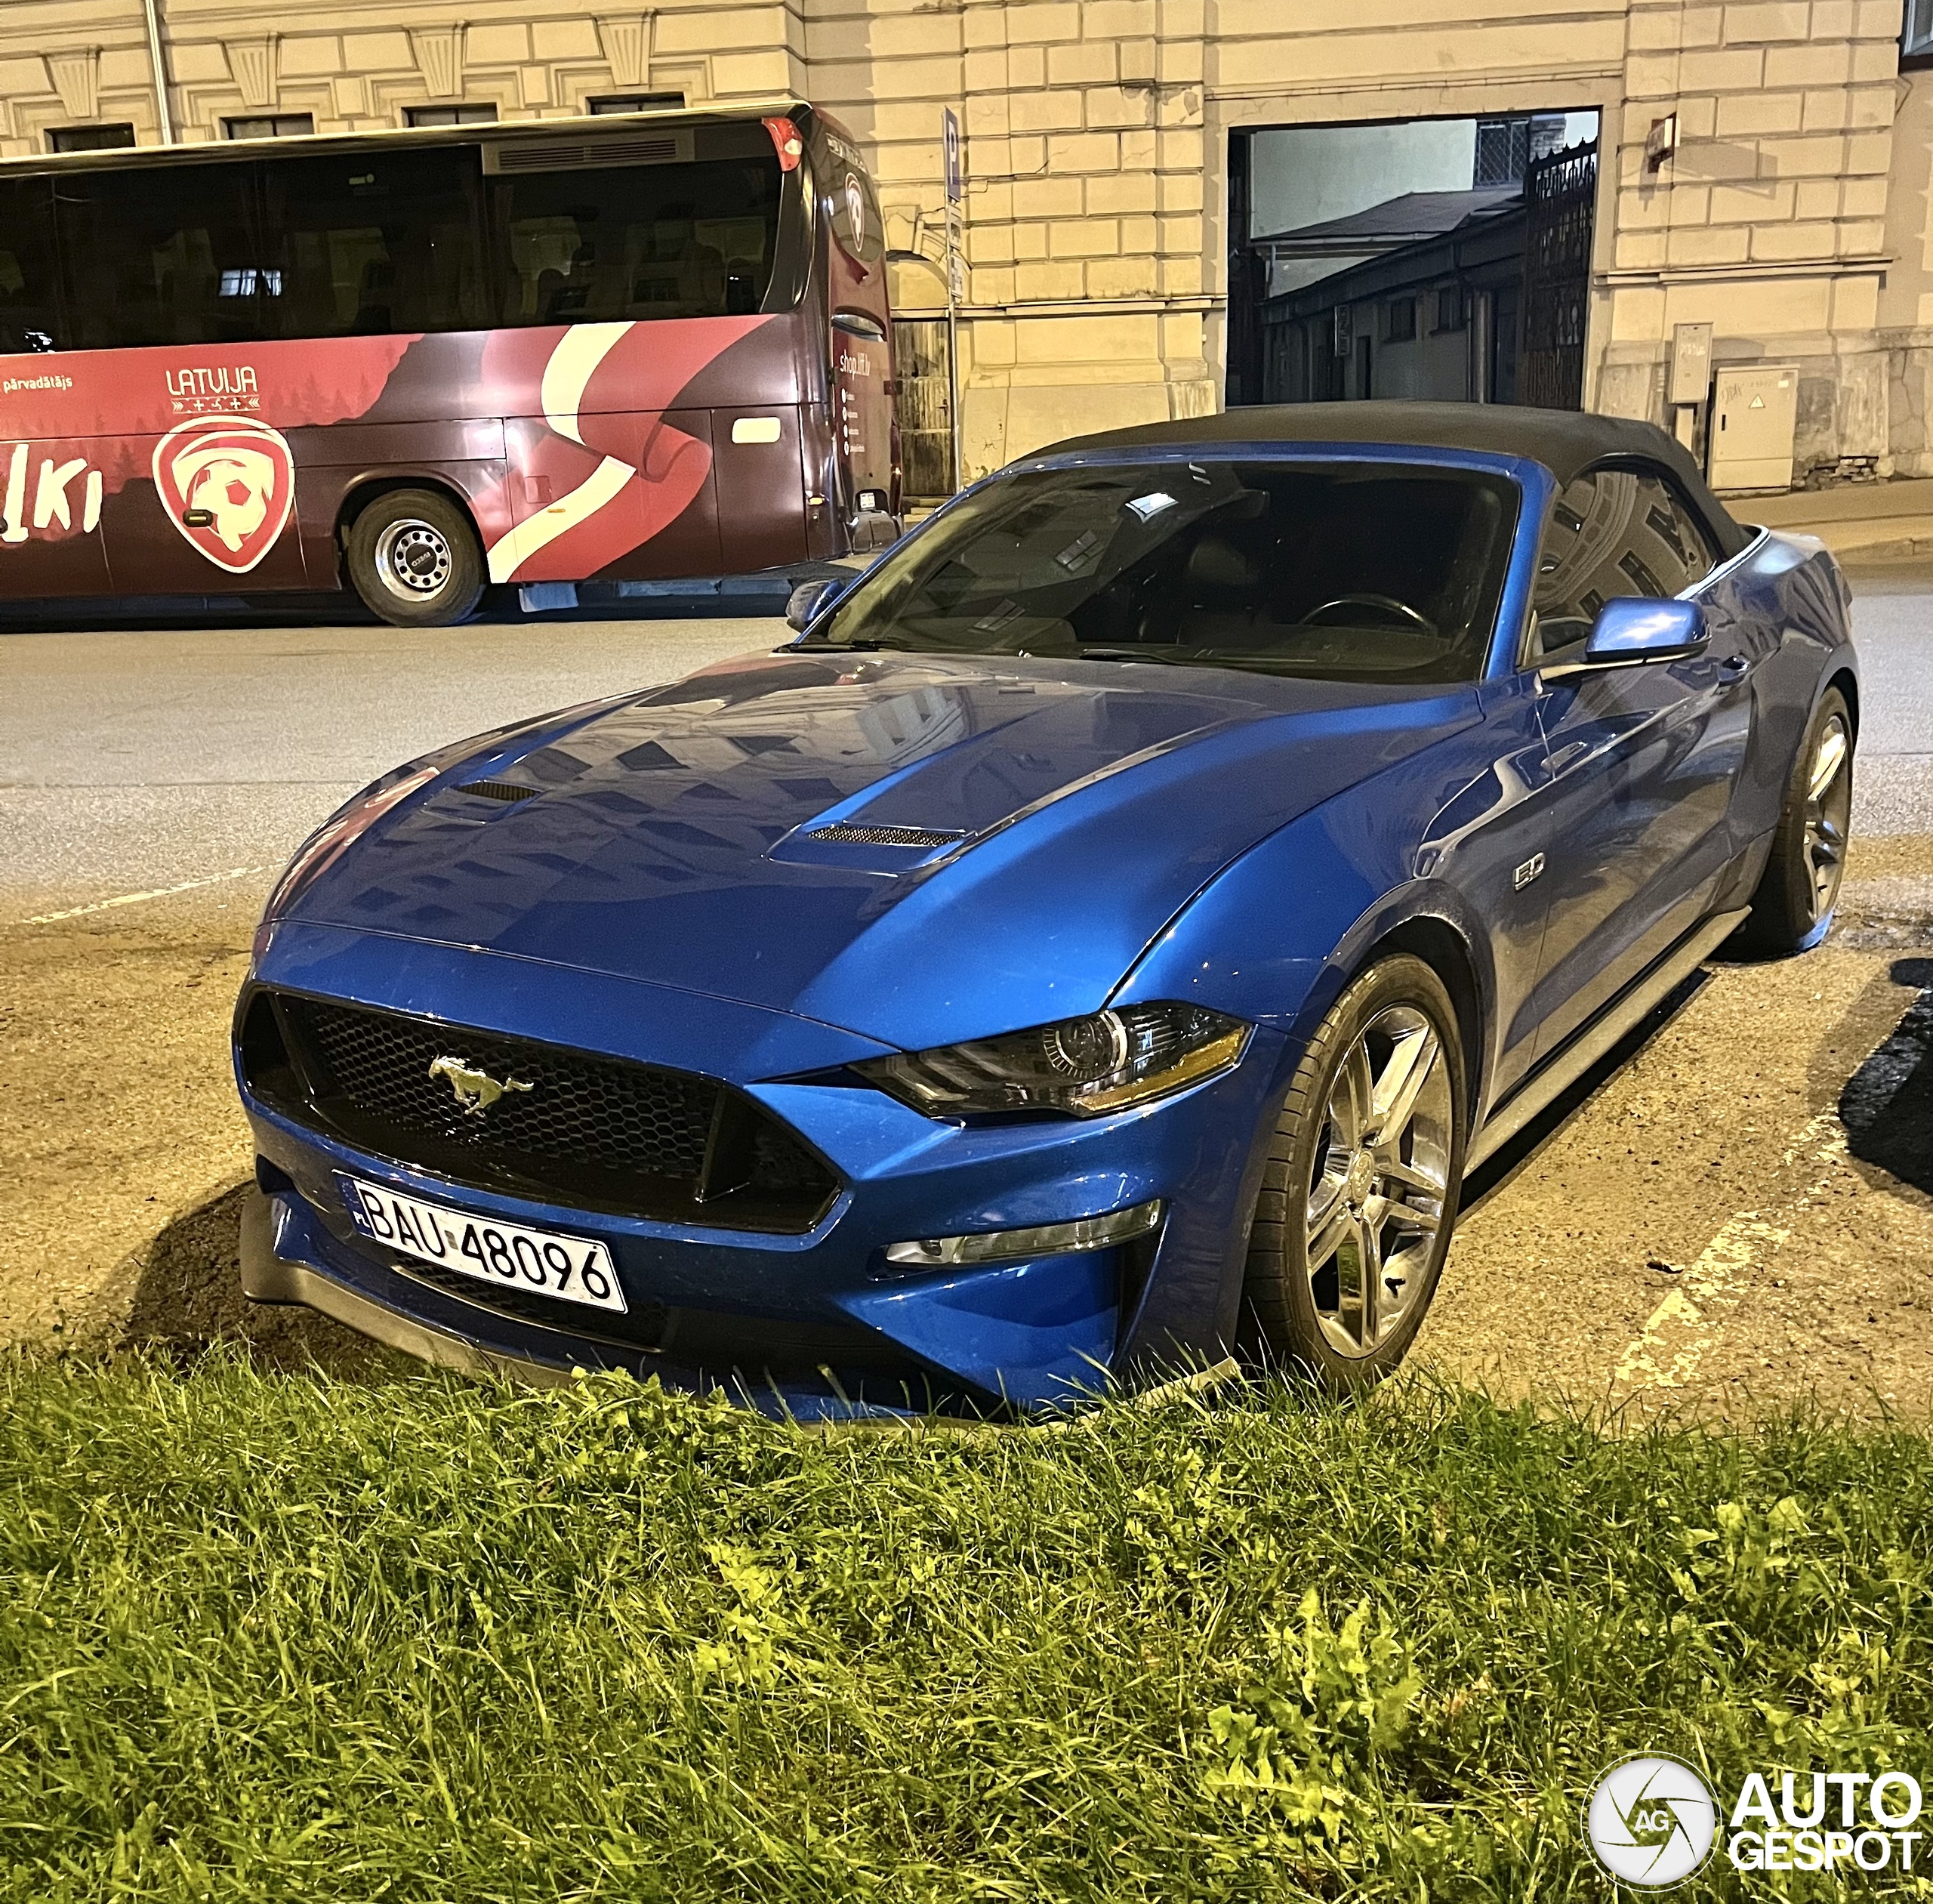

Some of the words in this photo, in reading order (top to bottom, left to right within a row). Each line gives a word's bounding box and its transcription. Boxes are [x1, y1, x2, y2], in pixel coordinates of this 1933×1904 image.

[948, 121, 957, 185] P
[2, 375, 73, 393] pārvadātājs
[165, 366, 258, 396] LATVIJA
[353, 1210, 371, 1229] PL
[359, 1188, 446, 1259] BAU
[460, 1223, 611, 1301] 48096
